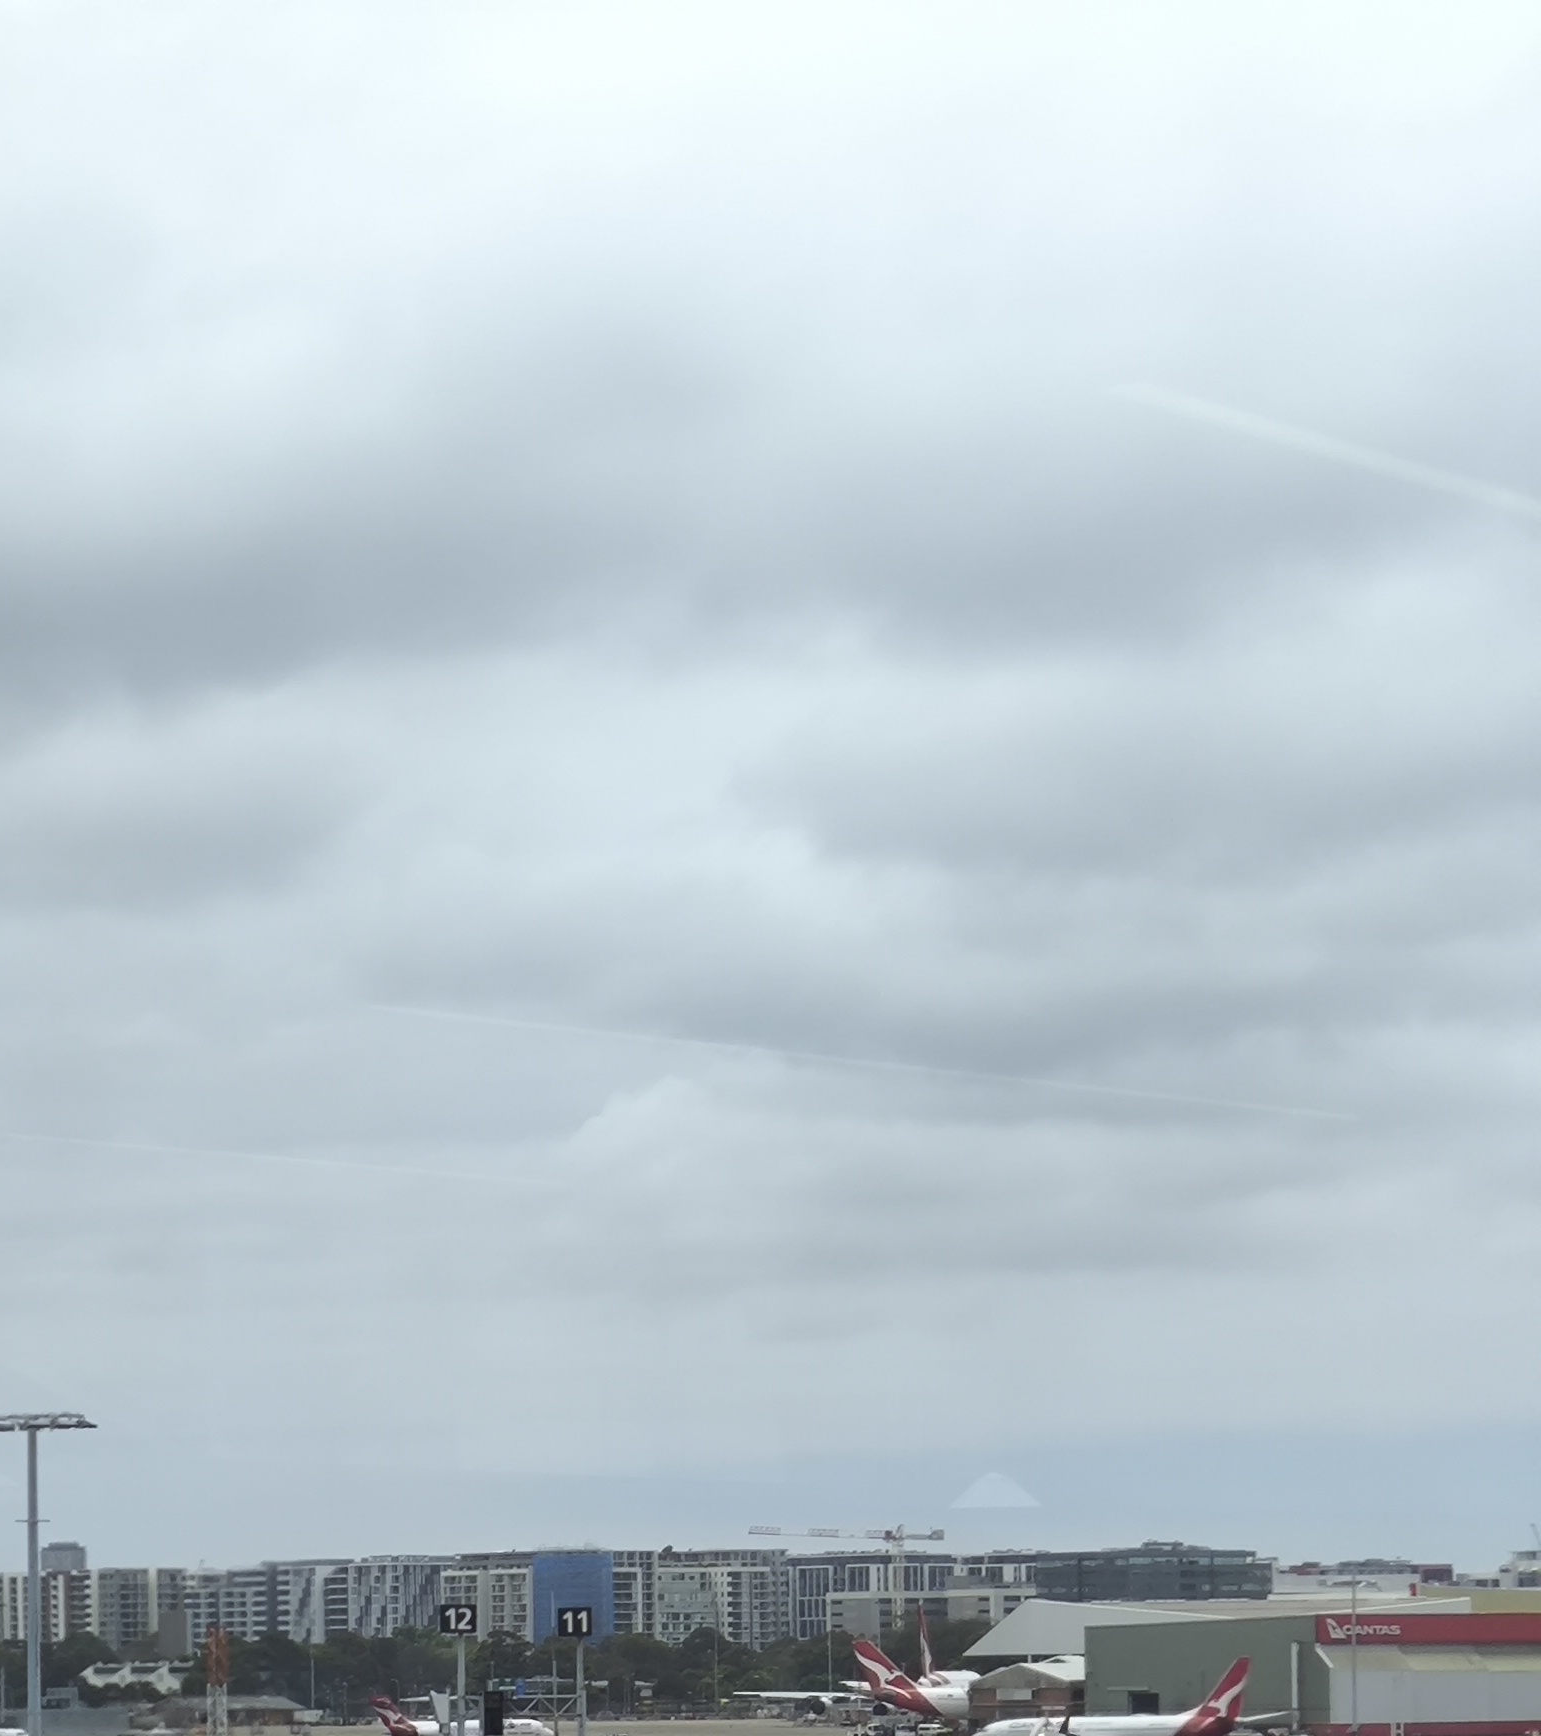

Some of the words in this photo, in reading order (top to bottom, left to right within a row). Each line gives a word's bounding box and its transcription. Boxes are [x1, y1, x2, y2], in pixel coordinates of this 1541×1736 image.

[445, 1607, 472, 1630] 12
[562, 1610, 588, 1633] 11
[1342, 1624, 1401, 1636] QANTAS
